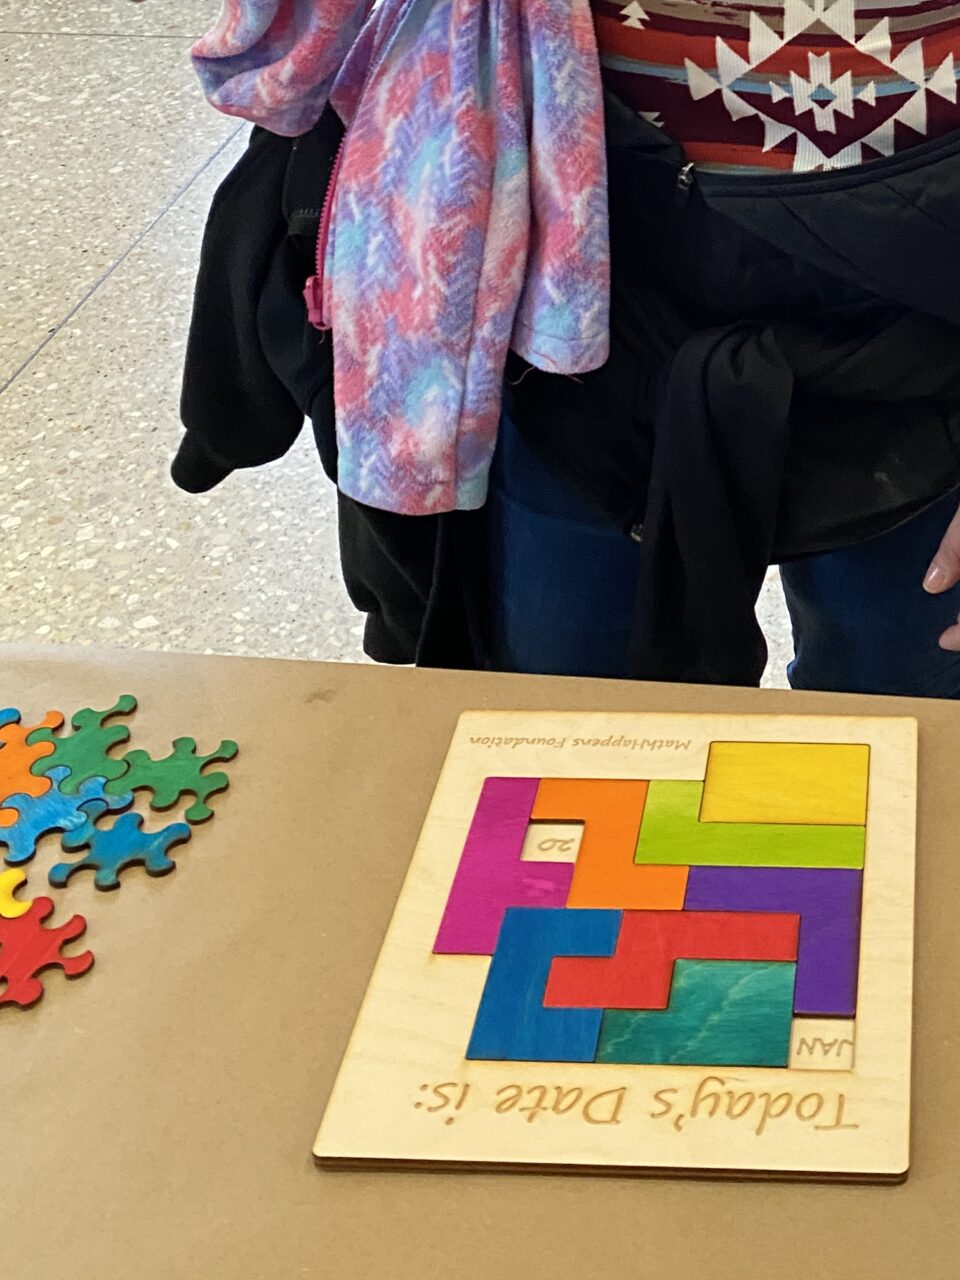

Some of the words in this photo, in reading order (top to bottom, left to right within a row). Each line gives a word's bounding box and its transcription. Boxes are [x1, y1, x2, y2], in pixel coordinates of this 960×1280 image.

[469, 736, 567, 749] Foundation
[572, 735, 692, 751] MathHappens
[537, 838, 575, 852] 20
[797, 1037, 854, 1057] JAN
[414, 1082, 471, 1126] is:
[495, 1084, 627, 1125] Date
[650, 1076, 859, 1136] Today's
